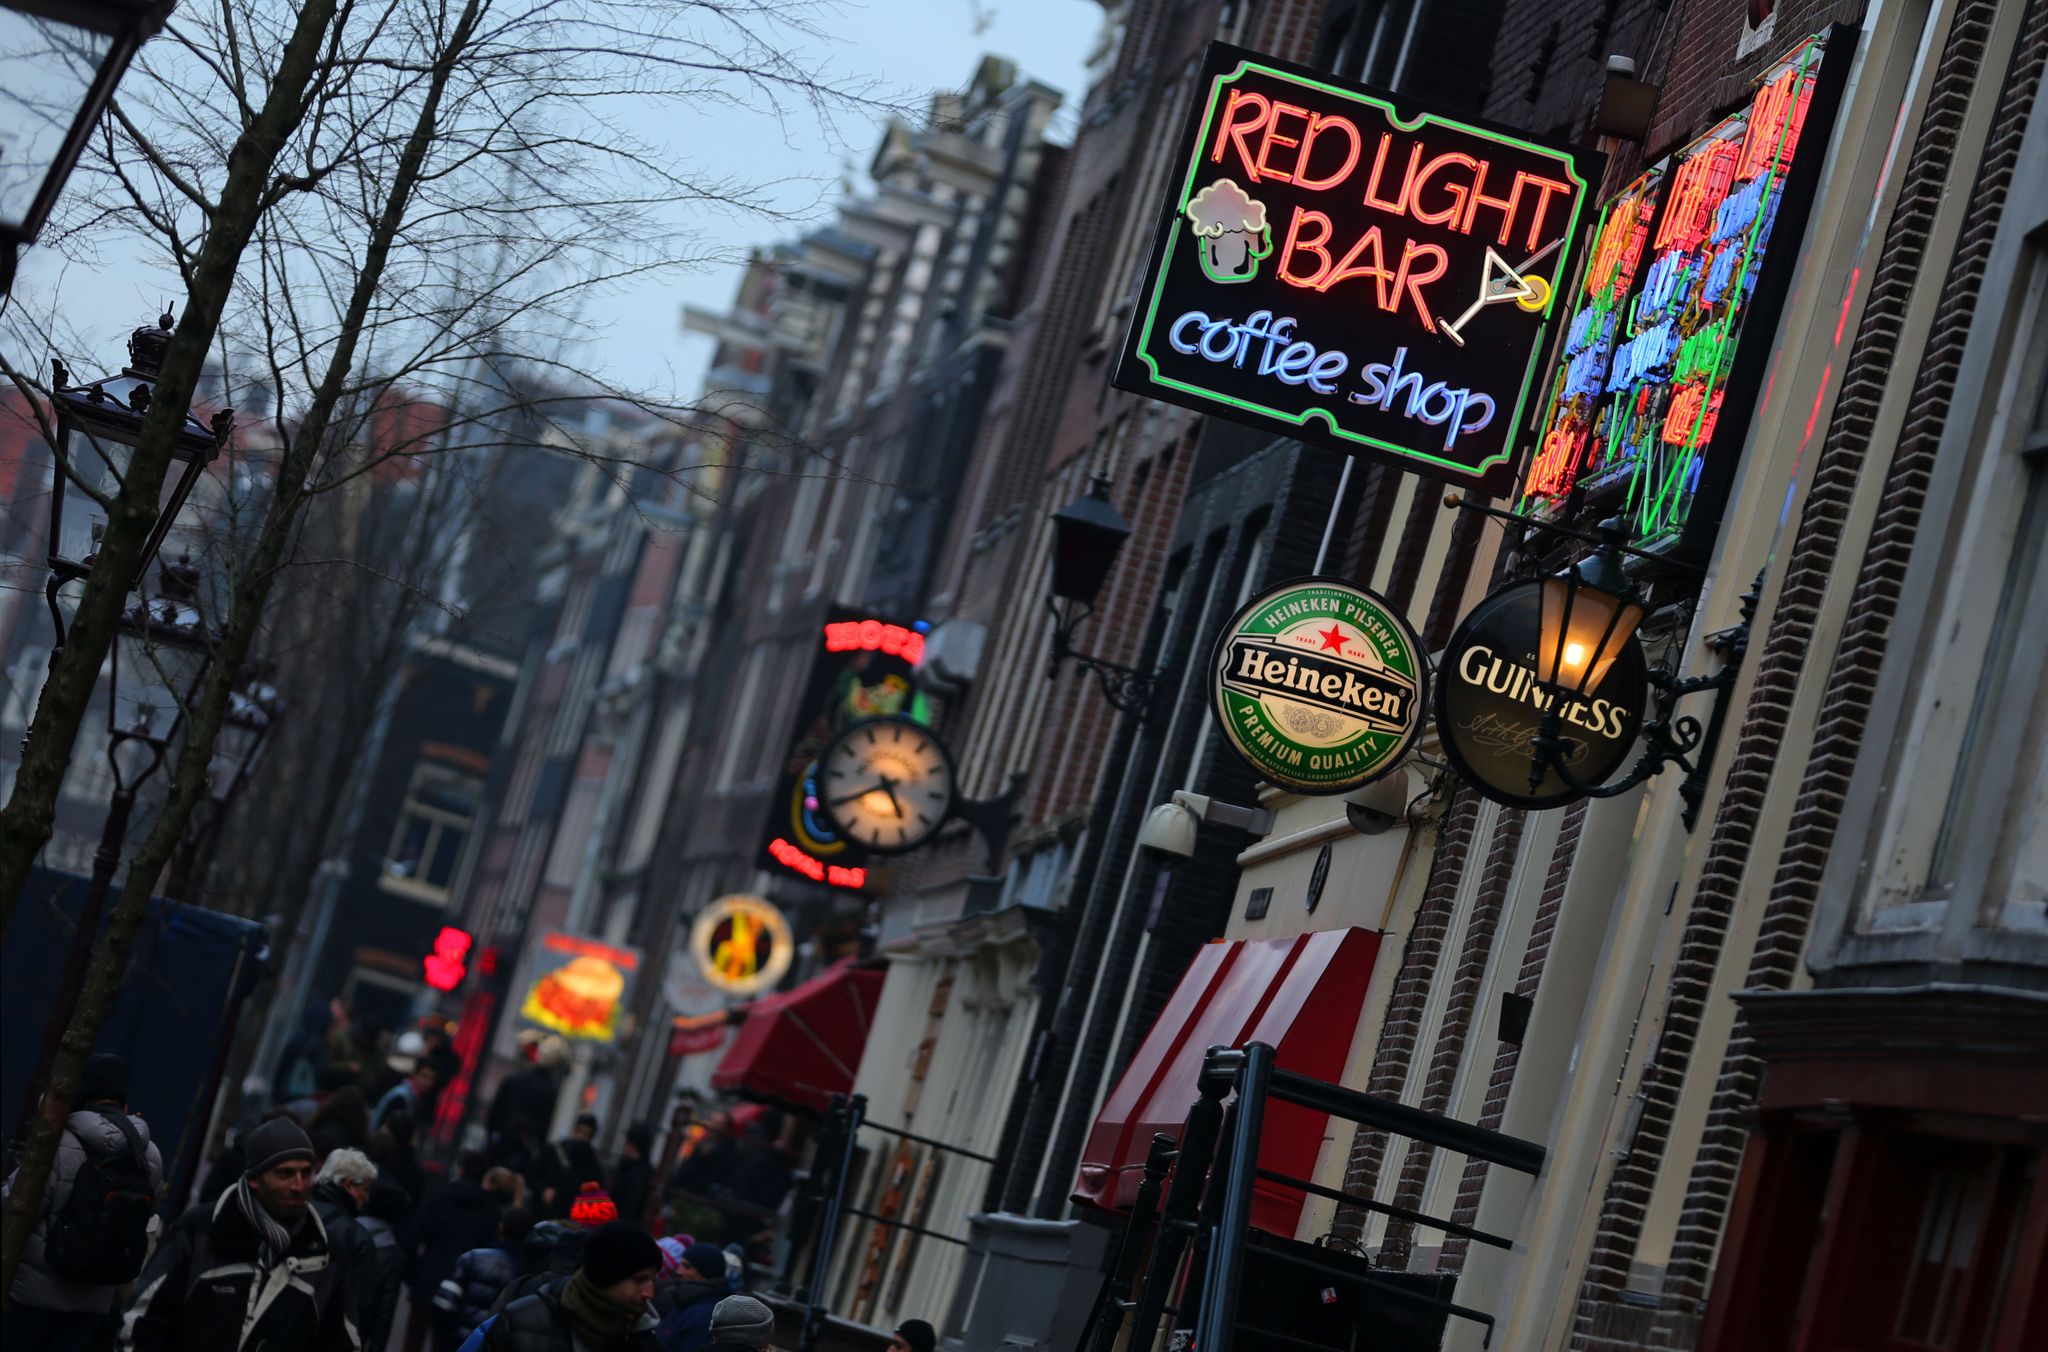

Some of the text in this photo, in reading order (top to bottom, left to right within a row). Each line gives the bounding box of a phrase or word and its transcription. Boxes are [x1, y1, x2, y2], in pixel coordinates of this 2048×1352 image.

[1211, 88, 1361, 191] RED
[1363, 131, 1571, 253] LIGHT
[1276, 205, 1448, 334] BAR
[1169, 310, 1348, 394] coffee
[1348, 347, 1496, 451] shop
[1264, 597, 1400, 659] HEINEKEN PILSENER
[1295, 635, 1366, 659] TRADE MARK
[1237, 648, 1401, 719] Heineken
[1239, 704, 1378, 770] PREMIUM QUALITY
